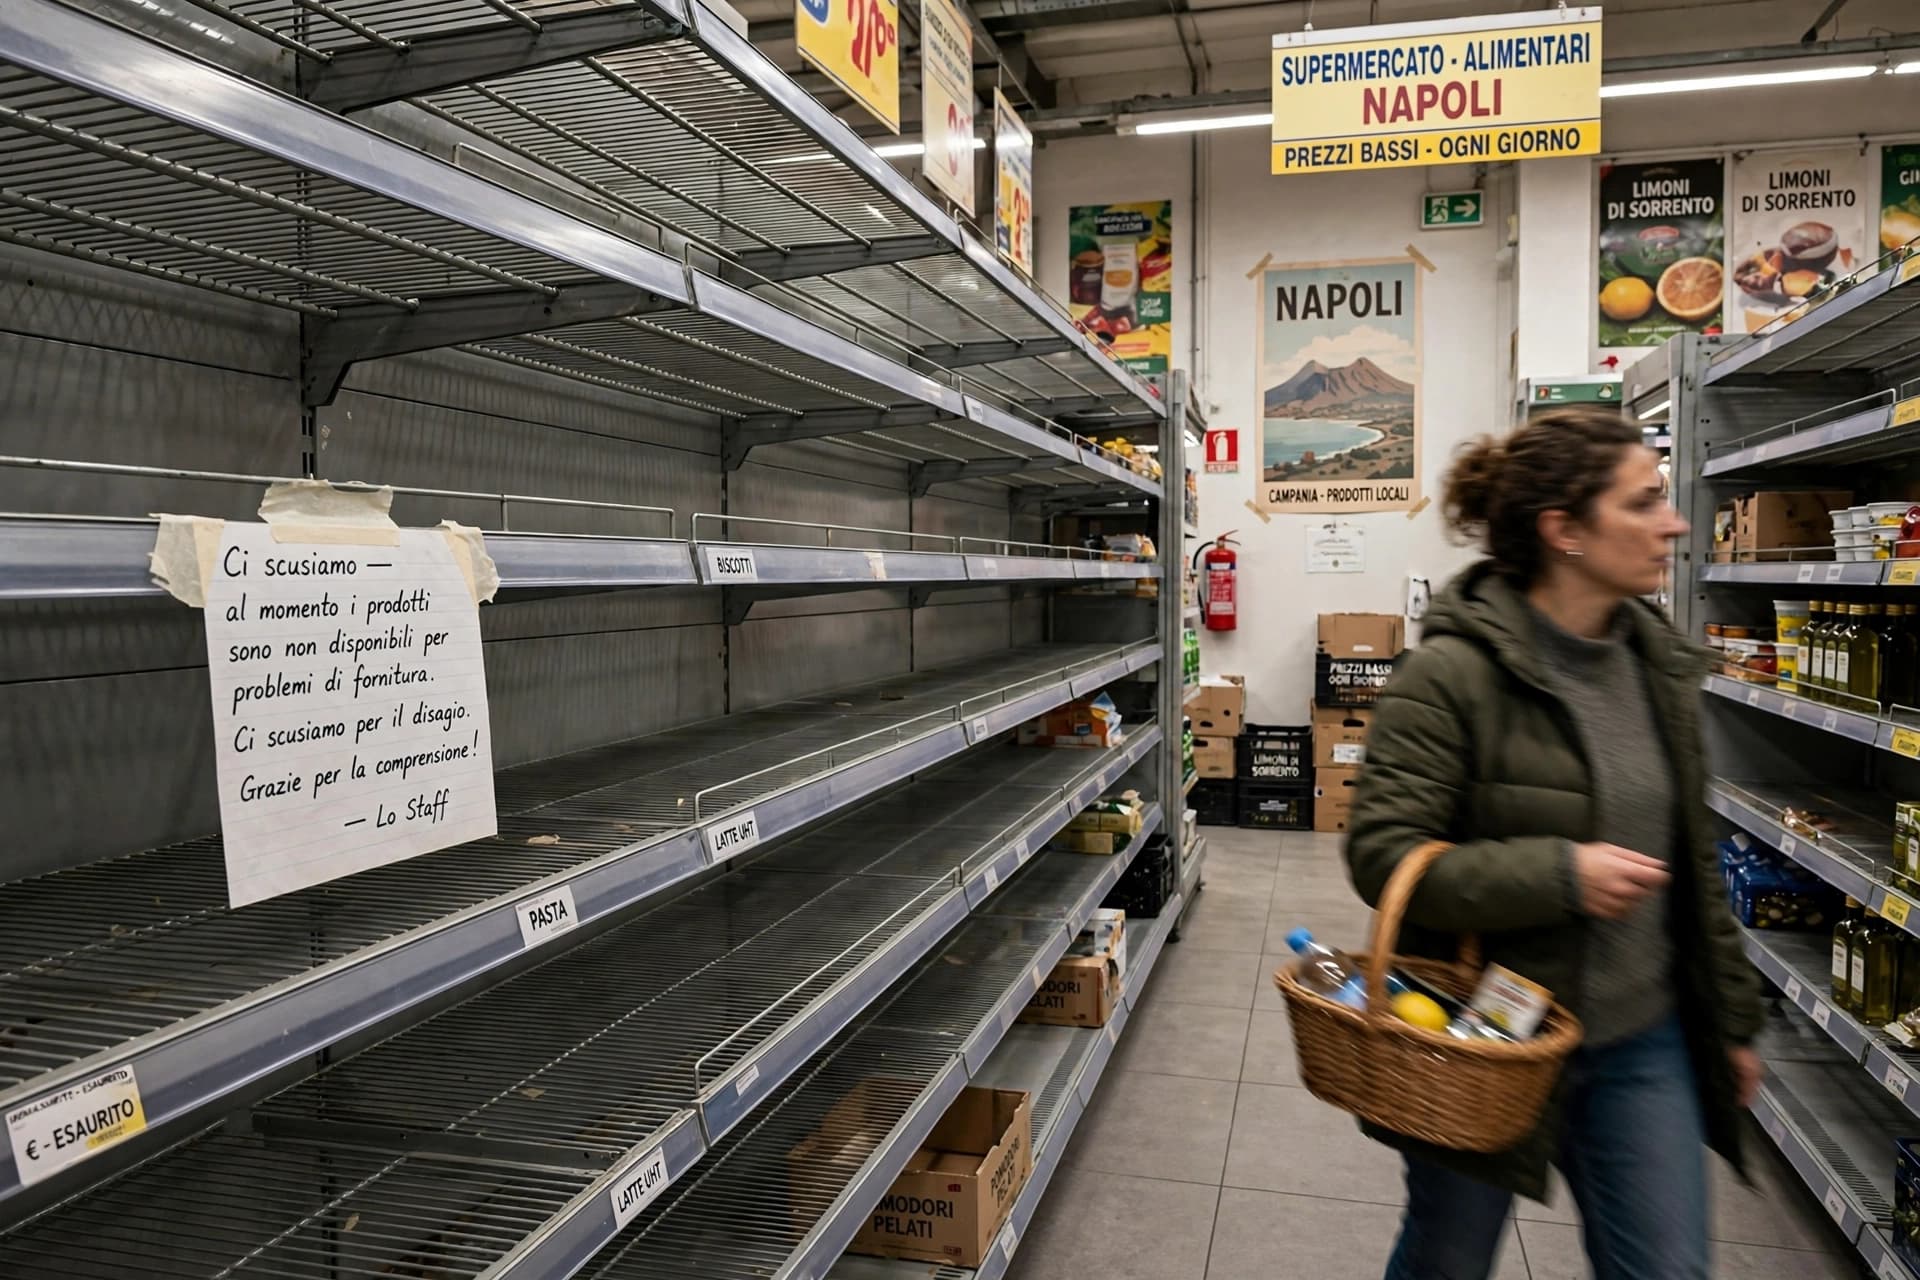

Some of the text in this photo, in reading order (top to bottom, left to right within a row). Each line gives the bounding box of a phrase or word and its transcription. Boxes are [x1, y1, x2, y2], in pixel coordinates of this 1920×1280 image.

[1281, 44, 1445, 86] SUPERMERCATO
[1464, 32, 1590, 72] ALIMENTARI
[1363, 79, 1502, 125] NAPOLI
[1285, 142, 1353, 168] PREZZI
[1361, 139, 1419, 163] BASSI
[1439, 135, 1490, 158] OGNI
[1497, 127, 1581, 154] GIORNO
[1633, 179, 1690, 198] LIMONI
[1769, 169, 1831, 190] LIMONI
[1608, 196, 1714, 220] DI SORRENTO
[1742, 190, 1856, 212] DI SORRENTO
[1276, 280, 1402, 321] NAPOLI
[1269, 489, 1318, 504] CAMPANIA
[1327, 487, 1373, 502] PRODOTTI
[1376, 487, 1409, 502] LOCALI
[223, 545, 249, 577] Ci
[264, 552, 357, 577] scusiamo
[718, 556, 752, 575] BISCOTTI
[226, 589, 431, 625] al momento i prodotti
[228, 623, 449, 663] sono non disponibili per
[232, 662, 435, 715] problemi di fornitura.
[234, 701, 471, 753] Ci scusiamo per il disagio.
[240, 771, 302, 802] Grazie
[313, 769, 342, 799] per
[351, 755, 367, 780] la
[376, 805, 396, 829] Lo
[406, 788, 450, 822] Staff
[715, 820, 755, 851] LATTE UHT
[529, 899, 568, 931] PASTA
[26, 1139, 40, 1160] €
[53, 1098, 135, 1149] ESAURITO
[617, 1161, 663, 1213] LATTE UHT
[873, 1195, 954, 1218] MODORI
[874, 1216, 932, 1238] PELATI
